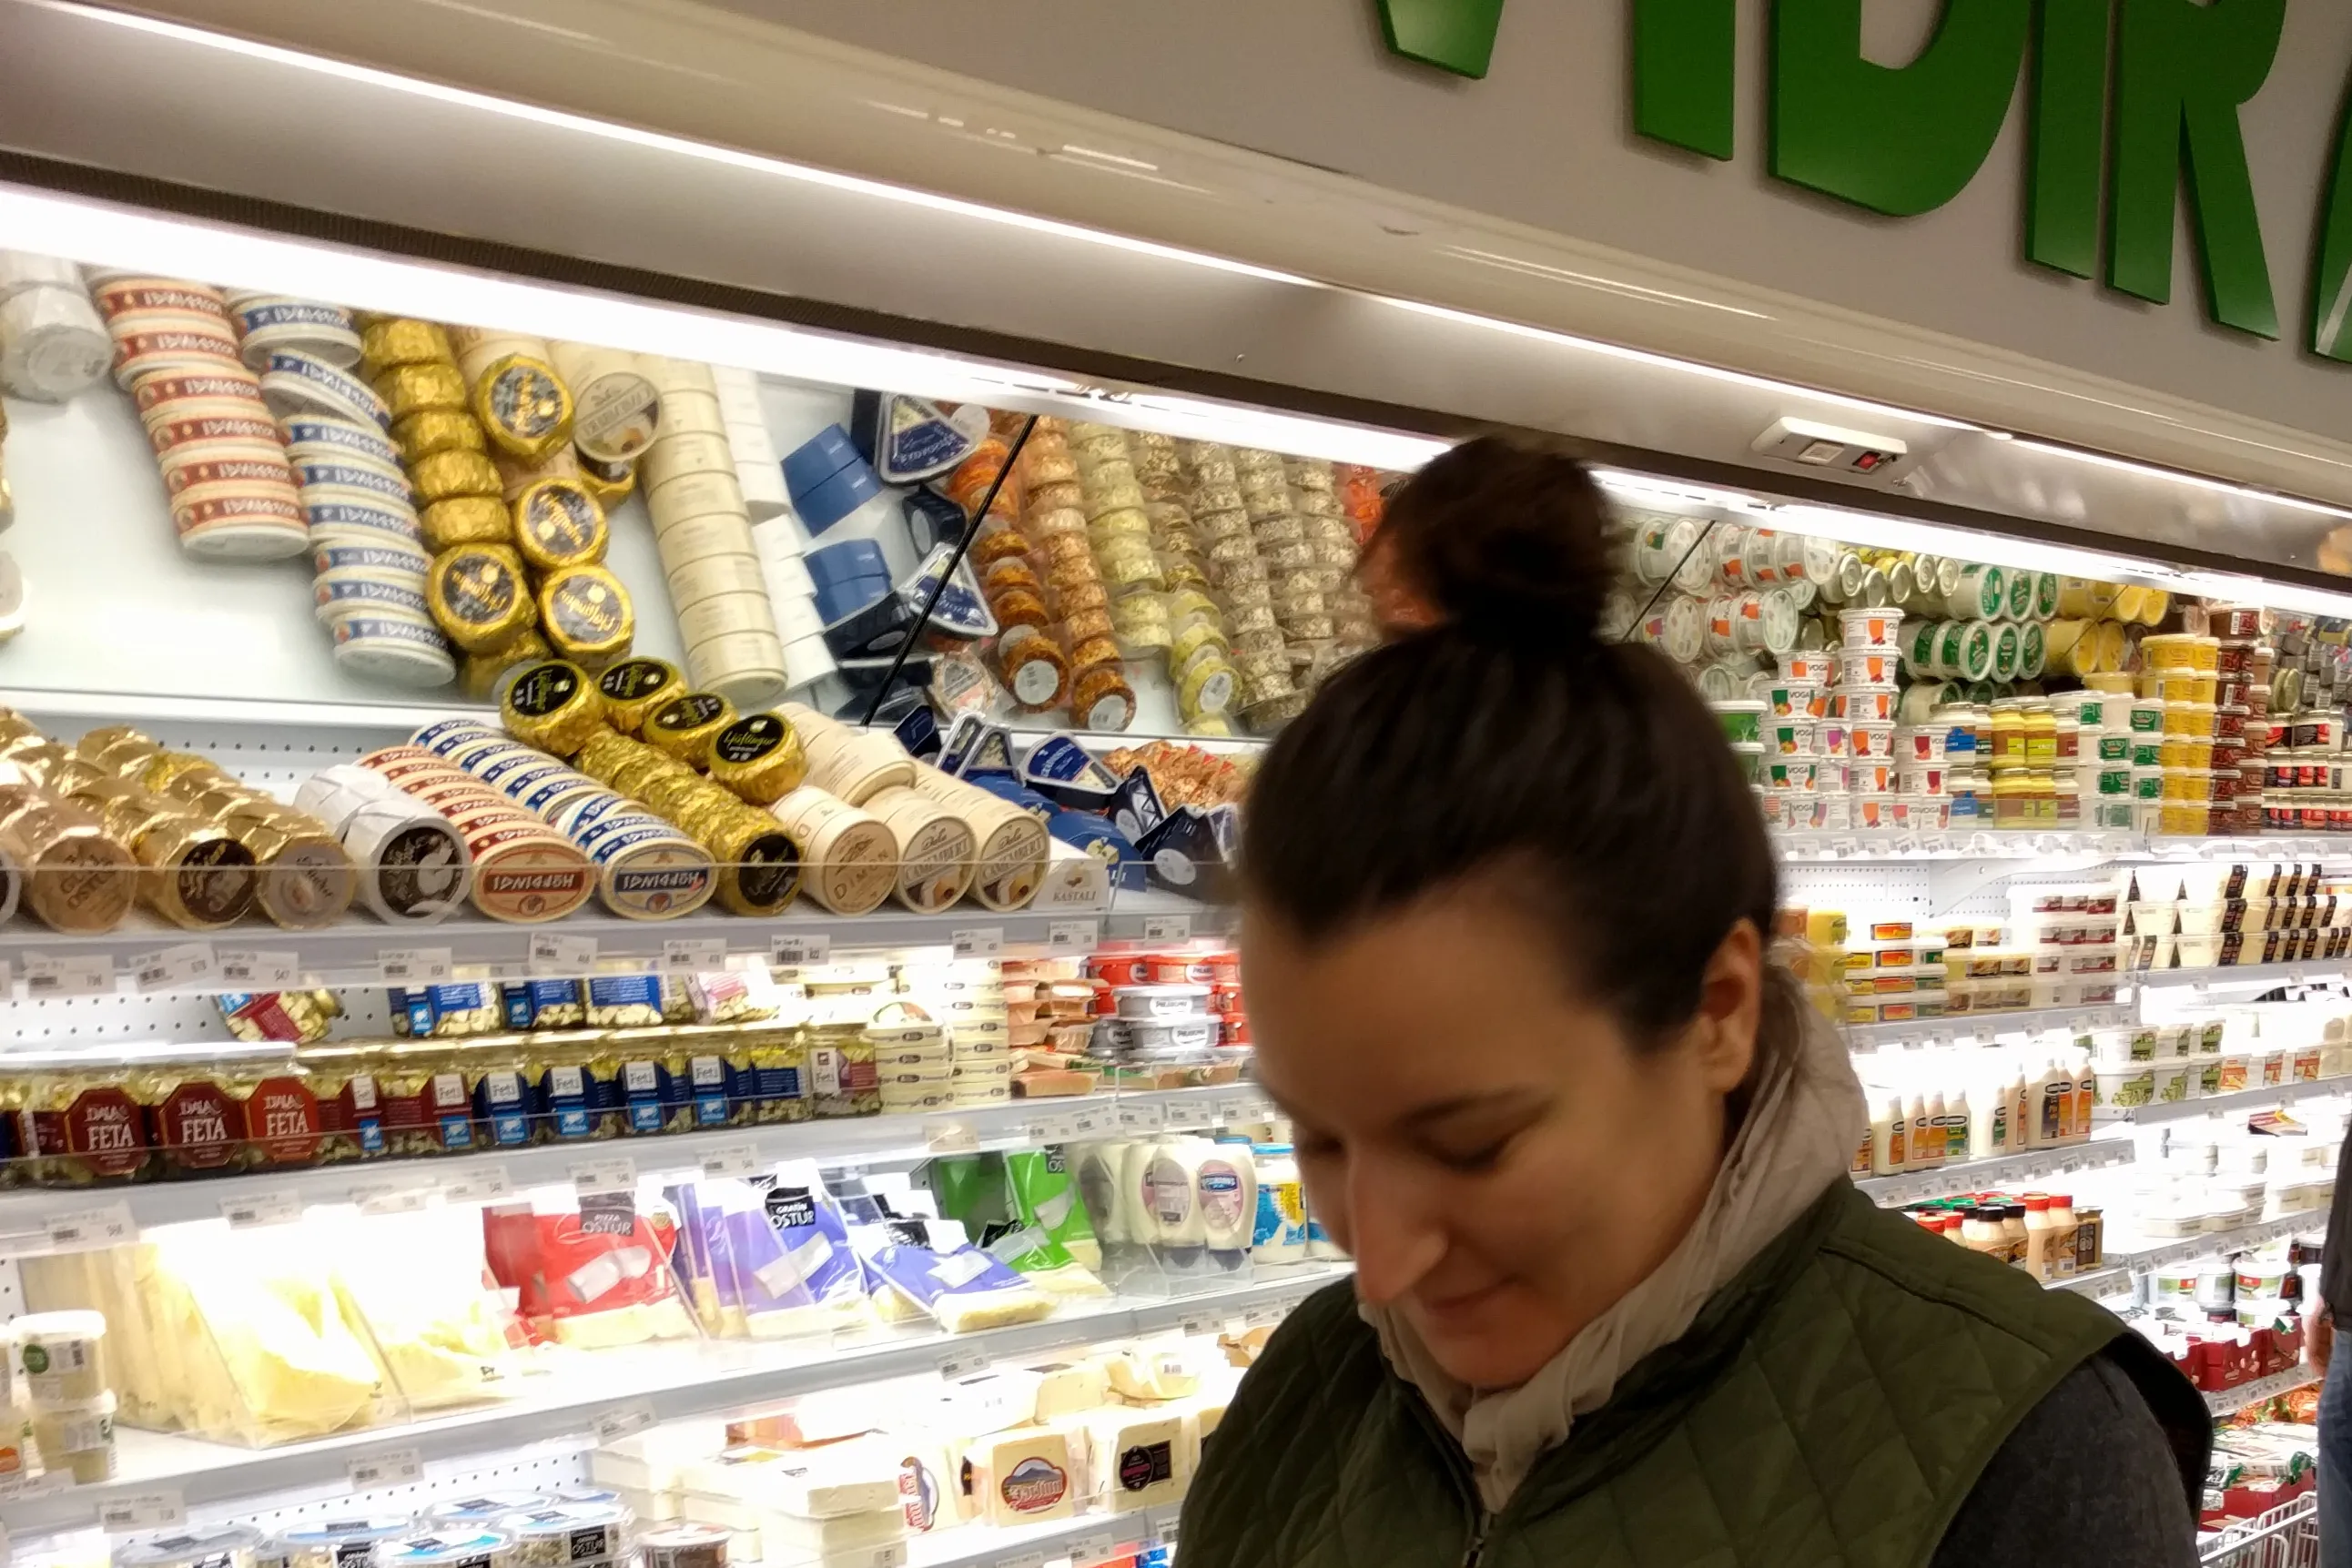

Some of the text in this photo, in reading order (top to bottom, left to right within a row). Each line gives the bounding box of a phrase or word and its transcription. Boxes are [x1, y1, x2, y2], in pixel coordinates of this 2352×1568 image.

[1052, 891, 1097, 902] KASTALI
[87, 1123, 136, 1150] FETA
[181, 1118, 228, 1144] FETA
[265, 1112, 309, 1138] FETA
[581, 1220, 633, 1237] OSTUR
[770, 1209, 815, 1229] OSTUR
